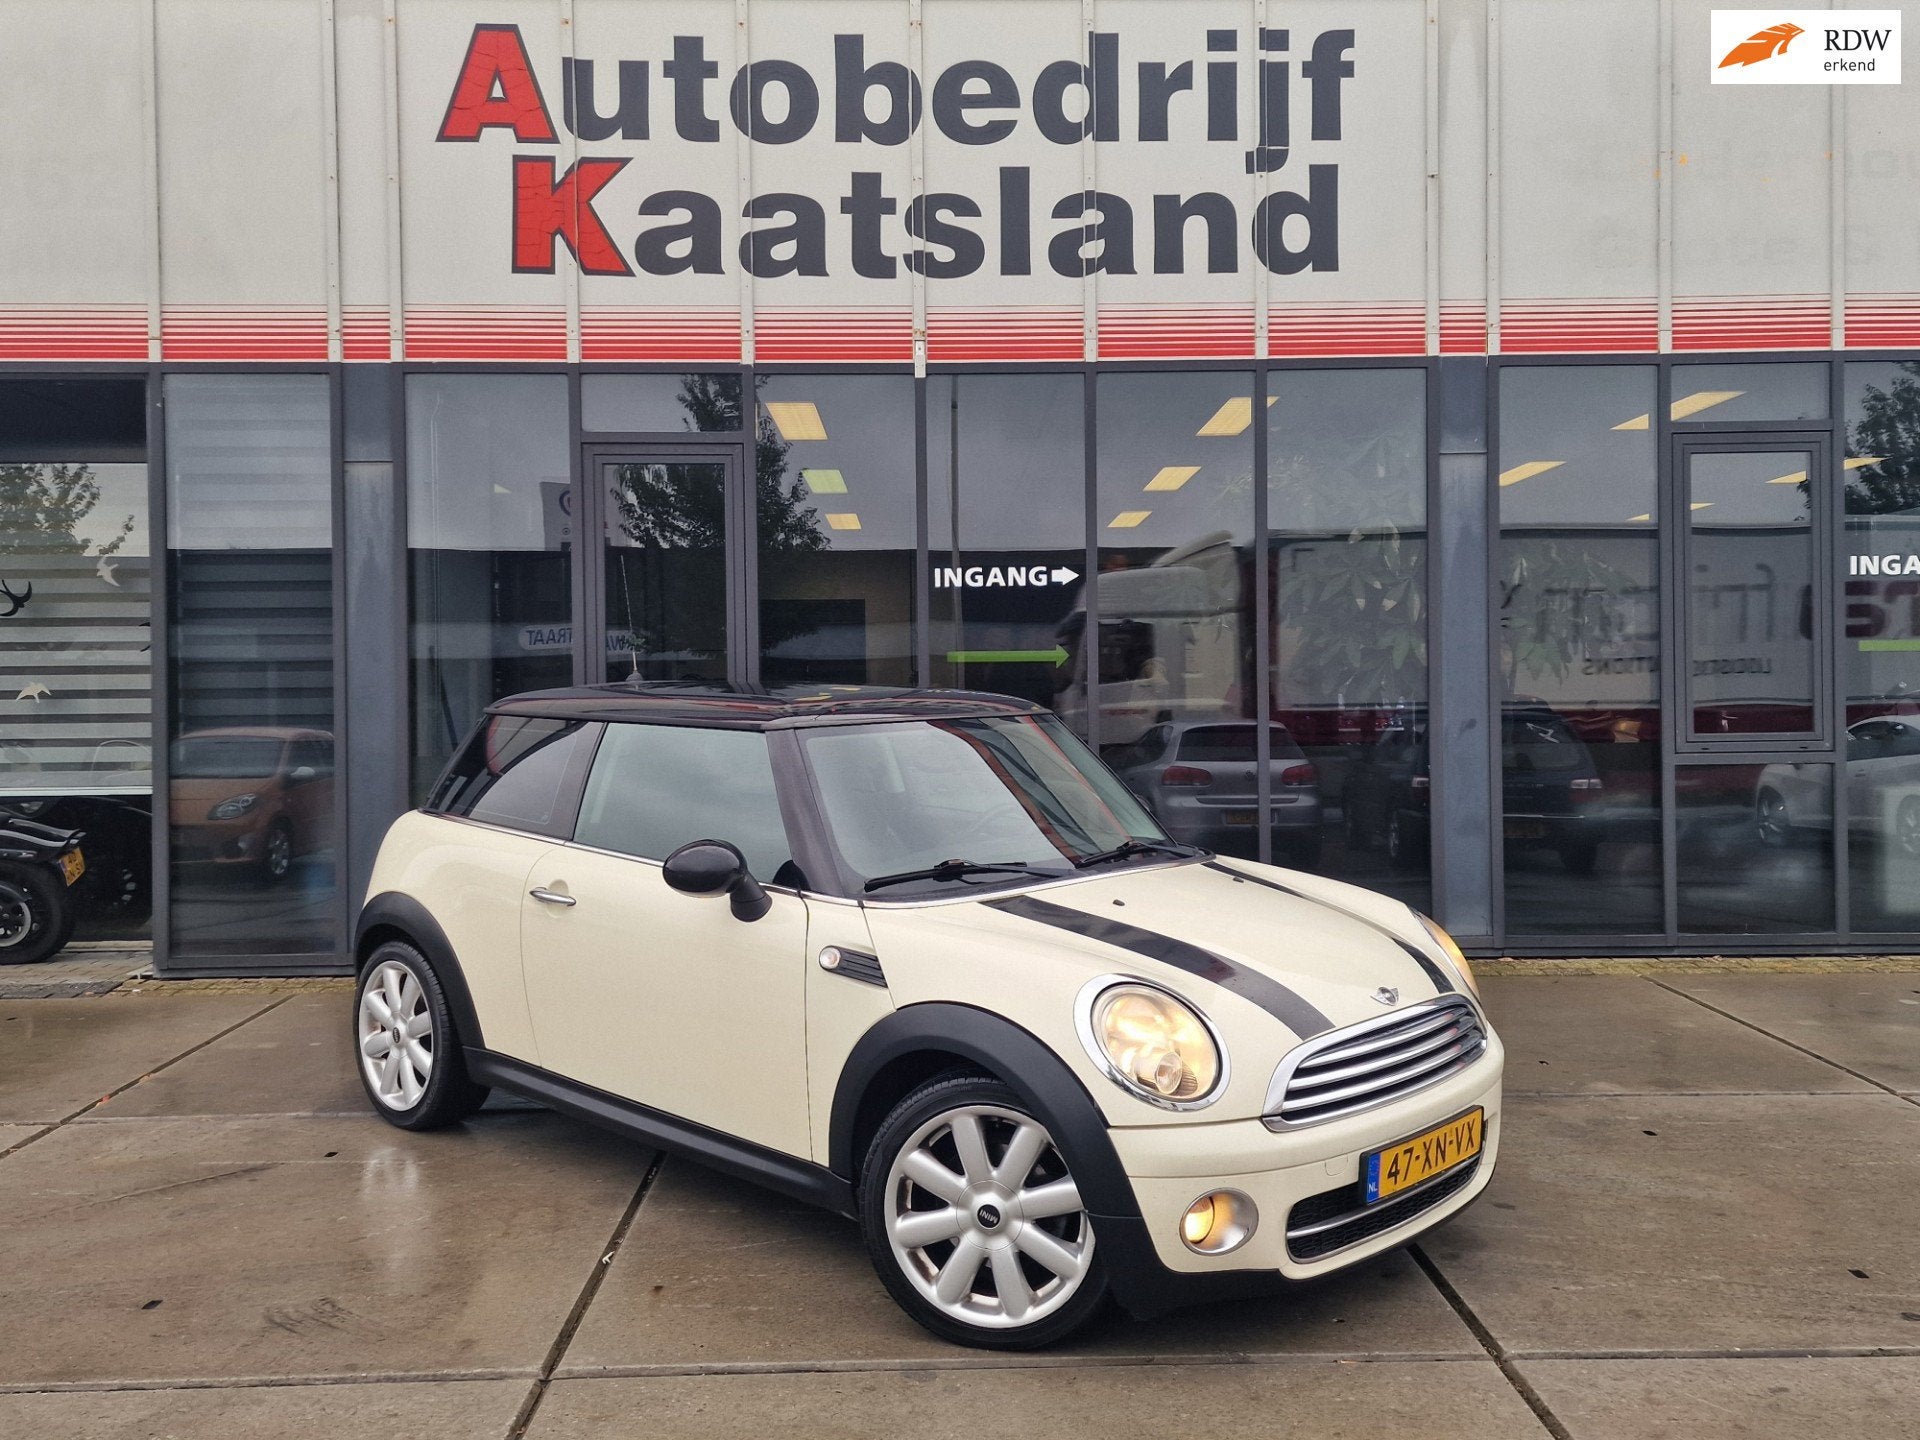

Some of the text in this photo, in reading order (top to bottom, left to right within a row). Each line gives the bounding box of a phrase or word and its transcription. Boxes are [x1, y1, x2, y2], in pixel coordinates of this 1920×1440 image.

[436, 23, 1355, 174] Autobedrijf
[511, 154, 1339, 279] Kaatsland
[934, 566, 1048, 588] INGANG
[1387, 1118, 1476, 1186] 47-XN-VX
[1368, 1182, 1378, 1193] NL
[979, 1209, 998, 1224] MINI
